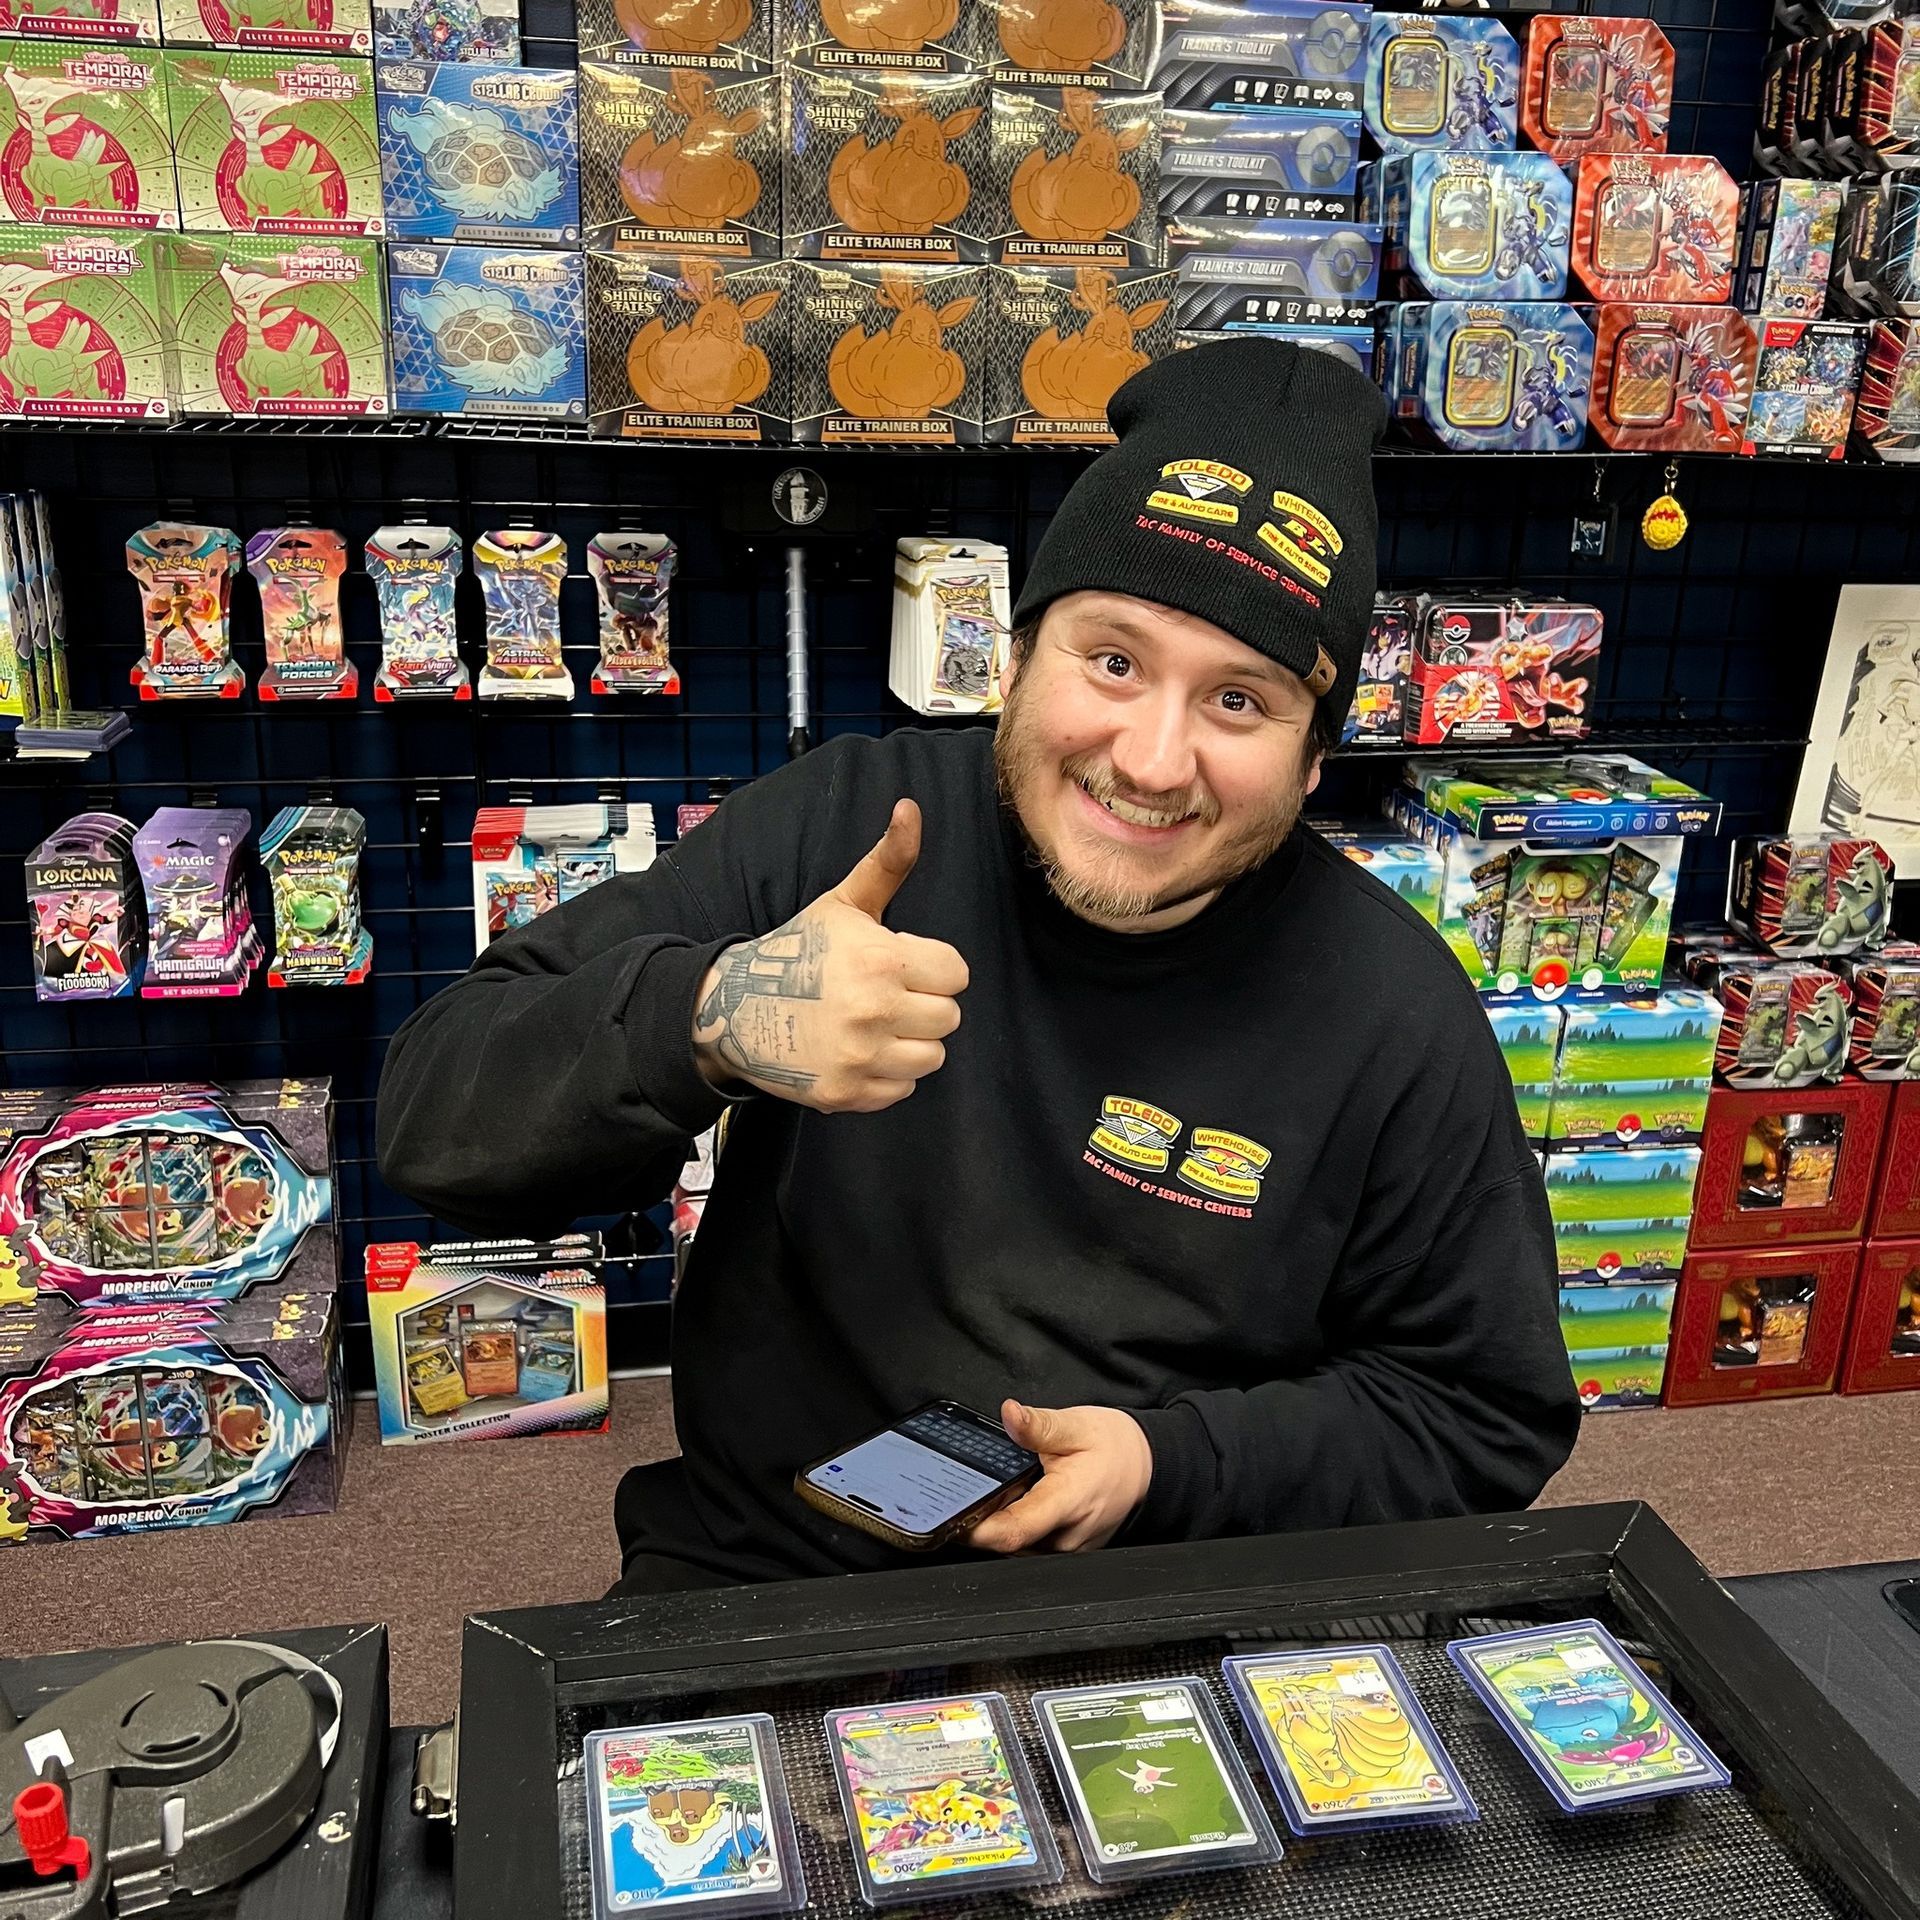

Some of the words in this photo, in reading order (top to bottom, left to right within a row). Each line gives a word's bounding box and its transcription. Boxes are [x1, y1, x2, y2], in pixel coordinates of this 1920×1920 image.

[26, 21, 57, 30] ELITE
[61, 22, 107, 32] TRAINER
[111, 25, 129, 33] BOX
[246, 33, 272, 42] ELITE
[277, 34, 320, 44] TRAINER
[325, 37, 344, 45] BOX
[1181, 38, 1232, 51] TRAINER'S
[1235, 42, 1275, 55] TOOLKIT
[614, 52, 650, 63] ELITE
[651, 53, 707, 67] TRAINER
[710, 56, 736, 68] BOX
[820, 51, 851, 64] ELITE
[855, 52, 913, 67] TRAINER
[916, 55, 942, 68] BOX
[64, 60, 152, 81] TEMPORAL
[74, 75, 143, 90] FORCES
[278, 71, 362, 91] TEMPORAL
[996, 72, 1028, 82] ELITE
[1029, 73, 1081, 84] TRAINER
[1083, 76, 1108, 86] BOX
[287, 86, 354, 99] FORCES
[473, 83, 520, 100] STELLAR
[522, 84, 561, 100] CROWN
[595, 102, 654, 115] SHINING
[806, 106, 864, 118] SHINING
[603, 114, 647, 128] FATES
[814, 117, 857, 131] FATES
[992, 122, 1045, 134] SHINING
[999, 132, 1039, 144] FATES
[1174, 153, 1224, 167] TRAINER'S
[1226, 157, 1266, 169] TOOLKIT
[50, 213, 76, 222] ELITE
[79, 214, 126, 223] TRAINER
[131, 216, 151, 225] BOX
[262, 222, 289, 231] ELITE
[293, 222, 336, 231] TRAINER
[340, 223, 359, 232] BOX
[620, 229, 654, 240] ELITE
[657, 230, 714, 243] TRAINER
[716, 233, 744, 244] BOX
[828, 236, 862, 248] ELITE
[865, 237, 922, 249] TRAINER
[925, 238, 952, 250] BOX
[47, 246, 139, 265] TEMPORAL
[1008, 243, 1040, 253] ELITE
[1043, 244, 1096, 254] TRAINER
[1098, 244, 1122, 255] BOX
[56, 262, 131, 274] FORCES
[280, 255, 367, 270] TEMPORAL
[1192, 260, 1243, 273] TRAINER'S
[1247, 263, 1286, 275] TOOLKIT
[289, 269, 357, 281] FORCES
[483, 266, 529, 281] STELLAR
[530, 267, 568, 281] CROWN
[602, 290, 663, 303] SHINING
[612, 301, 654, 315] FATES
[806, 298, 864, 310] SHINING
[1002, 301, 1058, 312] SHINING
[814, 309, 855, 322] FATES
[1010, 311, 1050, 324] FATES
[31, 404, 64, 412] ELITE
[68, 404, 113, 412] TRAINER
[118, 405, 138, 413] BOX
[263, 402, 290, 411] ELITE
[294, 403, 336, 411] TRAINER
[340, 404, 359, 412] BOX
[628, 415, 663, 426] ELITE
[666, 416, 724, 427] TRAINER
[726, 418, 753, 428] BOX
[828, 421, 862, 432] ELITE
[865, 421, 920, 432] TRAINER
[922, 422, 948, 432] BOX
[1020, 422, 1052, 432] ELITE
[1054, 422, 1107, 432] TRAINER
[1169, 461, 1246, 486] TOLEDO
[1152, 496, 1168, 504] TIRE
[1179, 502, 1205, 512] AUTO
[1207, 506, 1233, 518] CARE
[1277, 495, 1342, 550] WHITEHOUSE
[1136, 515, 1156, 530] TAC
[1158, 522, 1203, 544] FAMILY
[1206, 538, 1226, 552] OF
[1226, 546, 1278, 580] SERVICE
[1285, 544, 1304, 563] AUTO
[502, 649, 546, 657] ASTRAL
[155, 665, 199, 673] PARADOX
[282, 670, 332, 678] FORCES
[62, 858, 88, 866] Disney
[166, 856, 214, 865] MAGIC
[36, 868, 117, 886] LORCANA
[155, 959, 224, 974] KAMIGAWA
[287, 956, 343, 968] MASQUERADE
[59, 977, 110, 991] FLOODBORN
[1624, 981, 1646, 992] GO
[1110, 1099, 1173, 1130] TOLEDO
[1097, 1133, 1112, 1146] TIRE
[1119, 1143, 1141, 1157] AUTO
[1142, 1153, 1163, 1162] CARE
[1197, 1132, 1265, 1162] WHITEHOUSE
[1082, 1150, 1103, 1168] TAC
[1102, 1161, 1140, 1187] FAMILY
[1141, 1182, 1156, 1194] OF
[1156, 1187, 1202, 1209] SERVICE
[1204, 1201, 1252, 1218] CENTERS
[1186, 1164, 1199, 1175] TIRE
[1205, 1174, 1224, 1186] AUTO
[1225, 1181, 1254, 1191] SERVICE
[430, 1241, 471, 1250] POSTER
[473, 1239, 535, 1248] COLLECTION
[431, 1256, 472, 1264] POSTER
[474, 1253, 538, 1262] COLLECTION
[101, 1281, 169, 1296] MORPEKO
[167, 1274, 186, 1290] V
[183, 1279, 214, 1289] UNION
[538, 1275, 596, 1286] PRISMATIC
[94, 1315, 158, 1326] MORPEKO
[414, 1428, 450, 1440] POSTER
[453, 1414, 511, 1433] COLLECTION
[95, 1510, 163, 1526] MORPEKO
[162, 1503, 181, 1519] V
[178, 1505, 210, 1516] UNION
[1643, 1766, 1680, 1775] Venusaur
[1585, 1779, 1602, 1788] 340
[1324, 1800, 1343, 1808] 260
[1385, 1793, 1427, 1803] Ninetales
[1190, 1832, 1226, 1842] Slakoth
[968, 1853, 1006, 1864] Pikachu
[894, 1864, 916, 1873] 200
